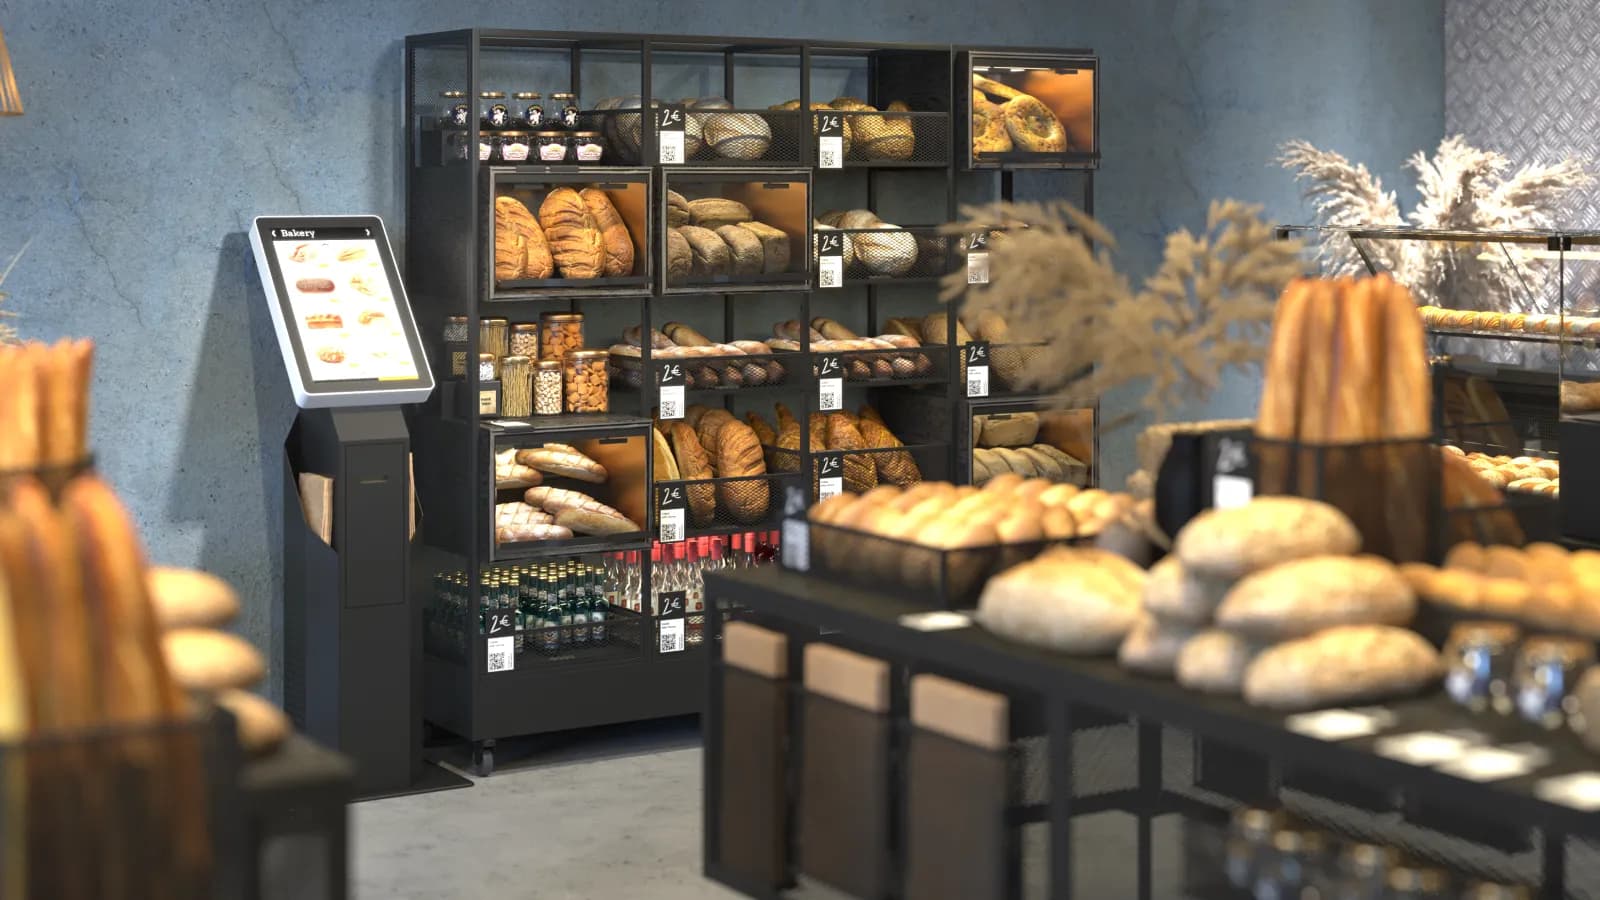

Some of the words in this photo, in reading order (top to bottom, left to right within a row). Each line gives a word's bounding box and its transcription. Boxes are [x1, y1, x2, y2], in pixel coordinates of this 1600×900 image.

[662, 108, 682, 127] 2€
[821, 115, 840, 133] 2€
[280, 228, 316, 239] Bakery
[969, 231, 986, 250] 2€
[821, 235, 840, 253] 2€
[969, 345, 986, 363] 2€
[662, 364, 682, 383] 2€
[821, 357, 840, 375] 2€
[821, 456, 840, 475] 2€
[662, 487, 682, 506] 2€
[662, 597, 682, 616] 2€
[490, 614, 512, 634] 2€
